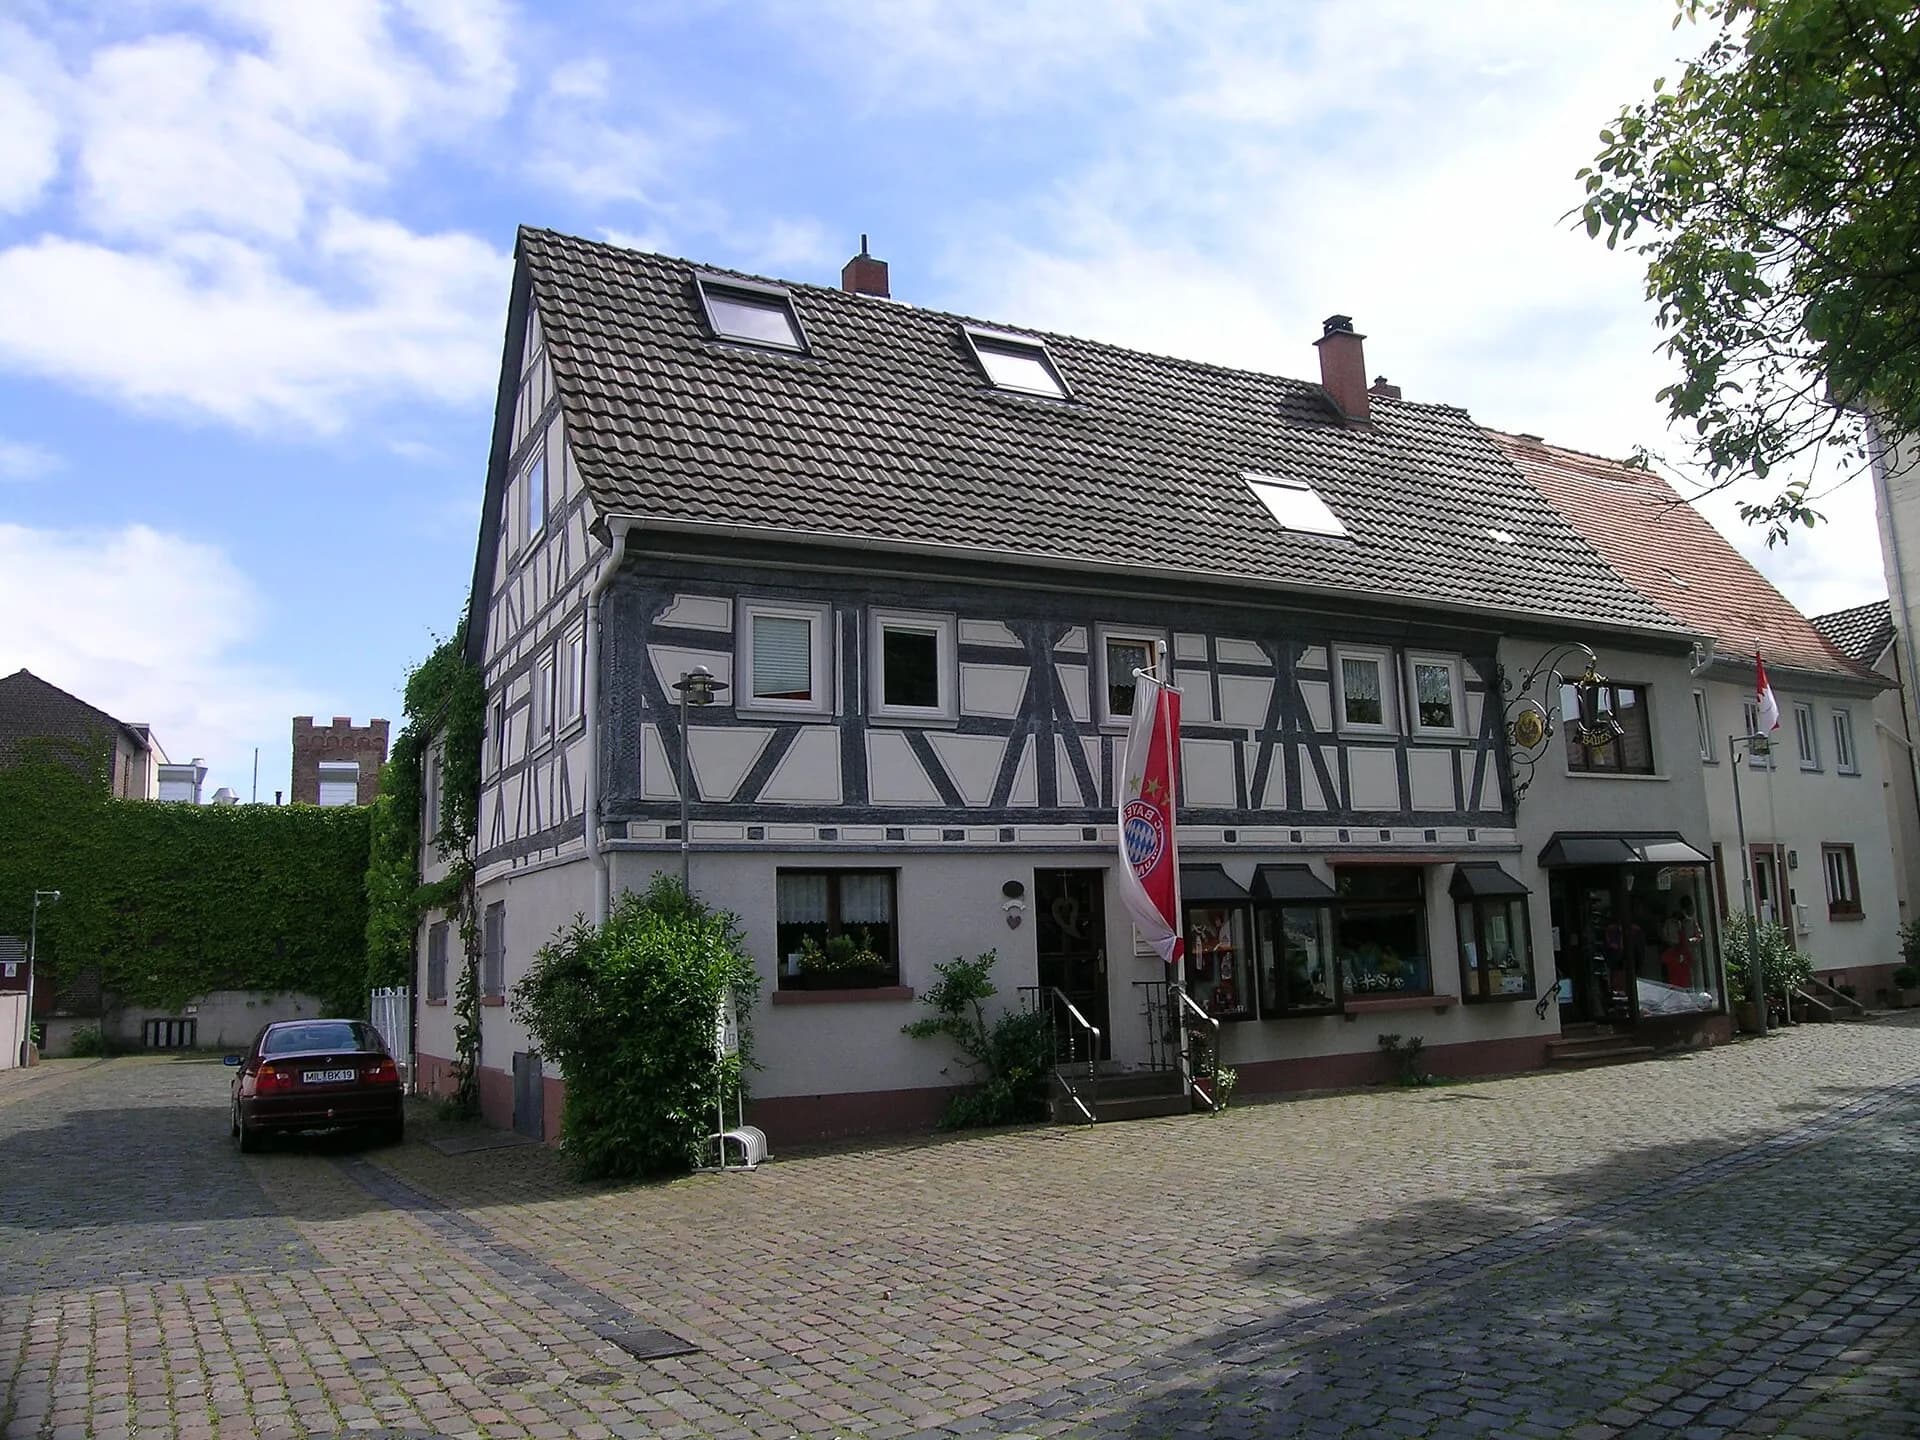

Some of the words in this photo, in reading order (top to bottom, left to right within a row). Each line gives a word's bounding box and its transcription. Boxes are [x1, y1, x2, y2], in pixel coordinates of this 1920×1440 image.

[306, 1072, 322, 1081] MIL
[327, 1071, 341, 1081] BK
[342, 1070, 353, 1079] 19
